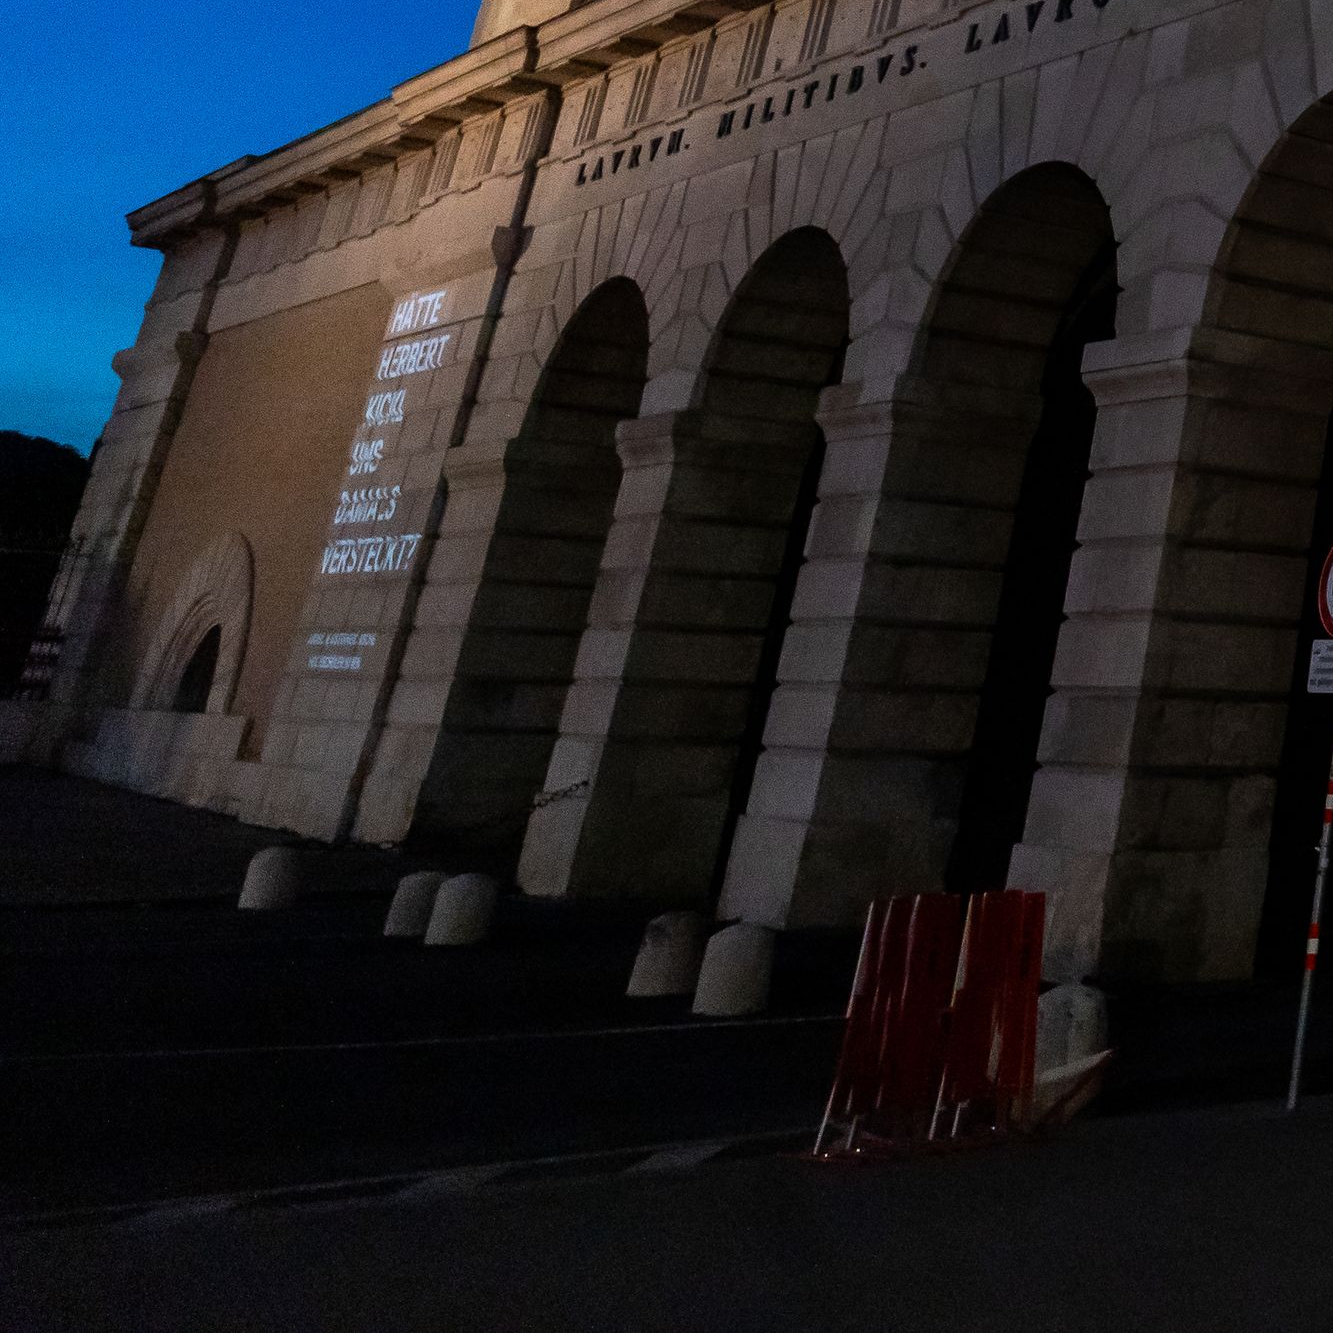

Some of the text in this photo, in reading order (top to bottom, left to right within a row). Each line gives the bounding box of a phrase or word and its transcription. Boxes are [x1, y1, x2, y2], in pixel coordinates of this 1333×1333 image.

[717, 46, 925, 138] MILITIBVS.
[391, 290, 446, 333] HÄTTE
[377, 335, 450, 380] HERBERT
[349, 440, 383, 475] UNS
[321, 534, 422, 574] VERSTECKT?
